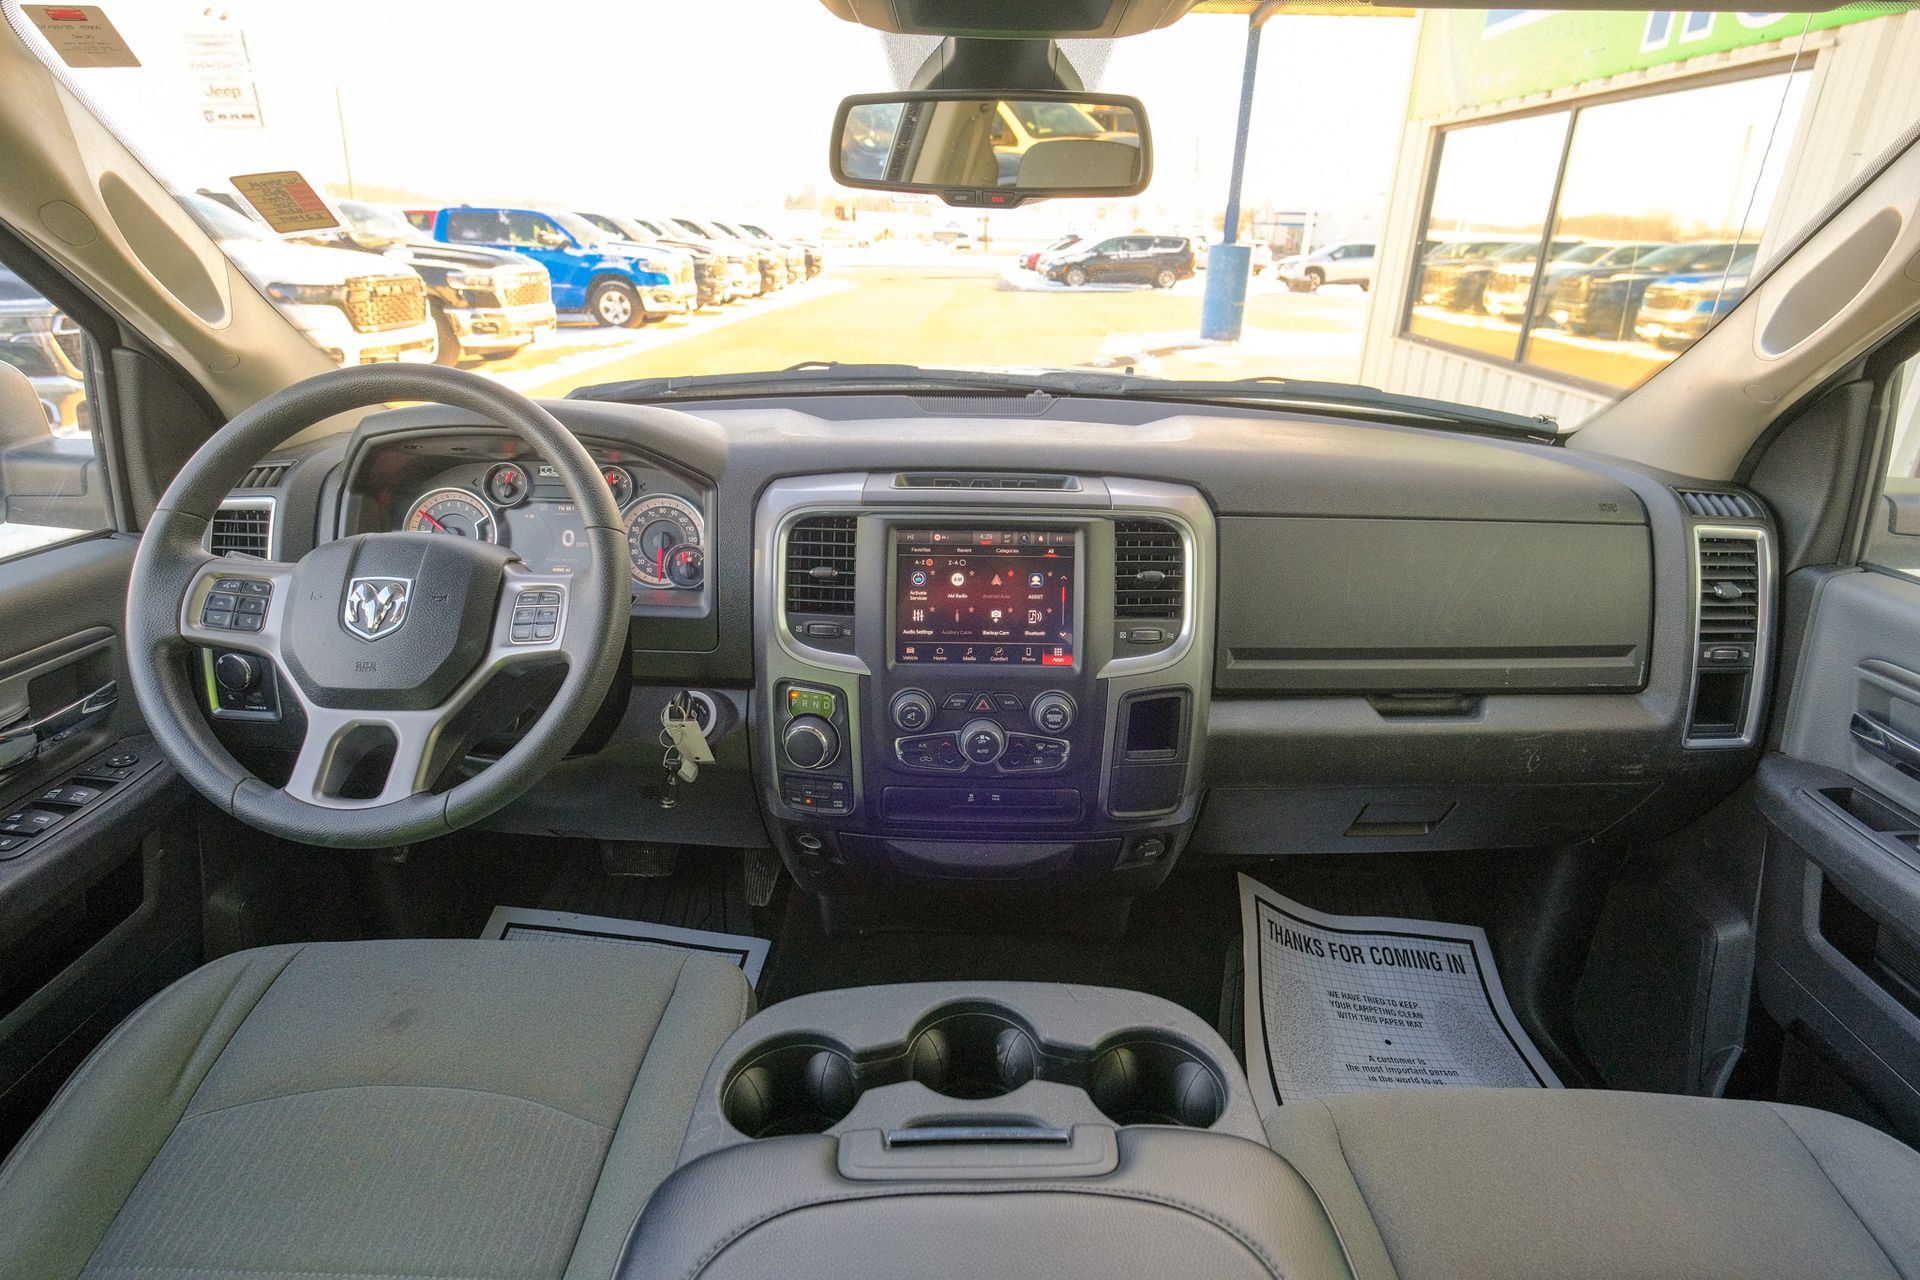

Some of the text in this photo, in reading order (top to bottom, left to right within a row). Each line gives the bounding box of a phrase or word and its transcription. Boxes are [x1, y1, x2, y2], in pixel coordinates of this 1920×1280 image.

[206, 84, 241, 98] Jeep
[562, 530, 575, 548] 0
[1267, 919, 1466, 974] THANKS FOR COMING IN
[1327, 990, 1418, 1010] WE HAVE TRIED TO KEEP
[1330, 1000, 1424, 1020] YOUR CARPETING CLEAN
[1337, 1011, 1358, 1021] WITH
[1359, 1014, 1377, 1024] THIS
[1379, 1017, 1405, 1028] PAPER
[1345, 1063, 1360, 1072] the
[1386, 1066, 1427, 1076] important
[1377, 1056, 1415, 1065] customer
[1417, 1057, 1427, 1066] is
